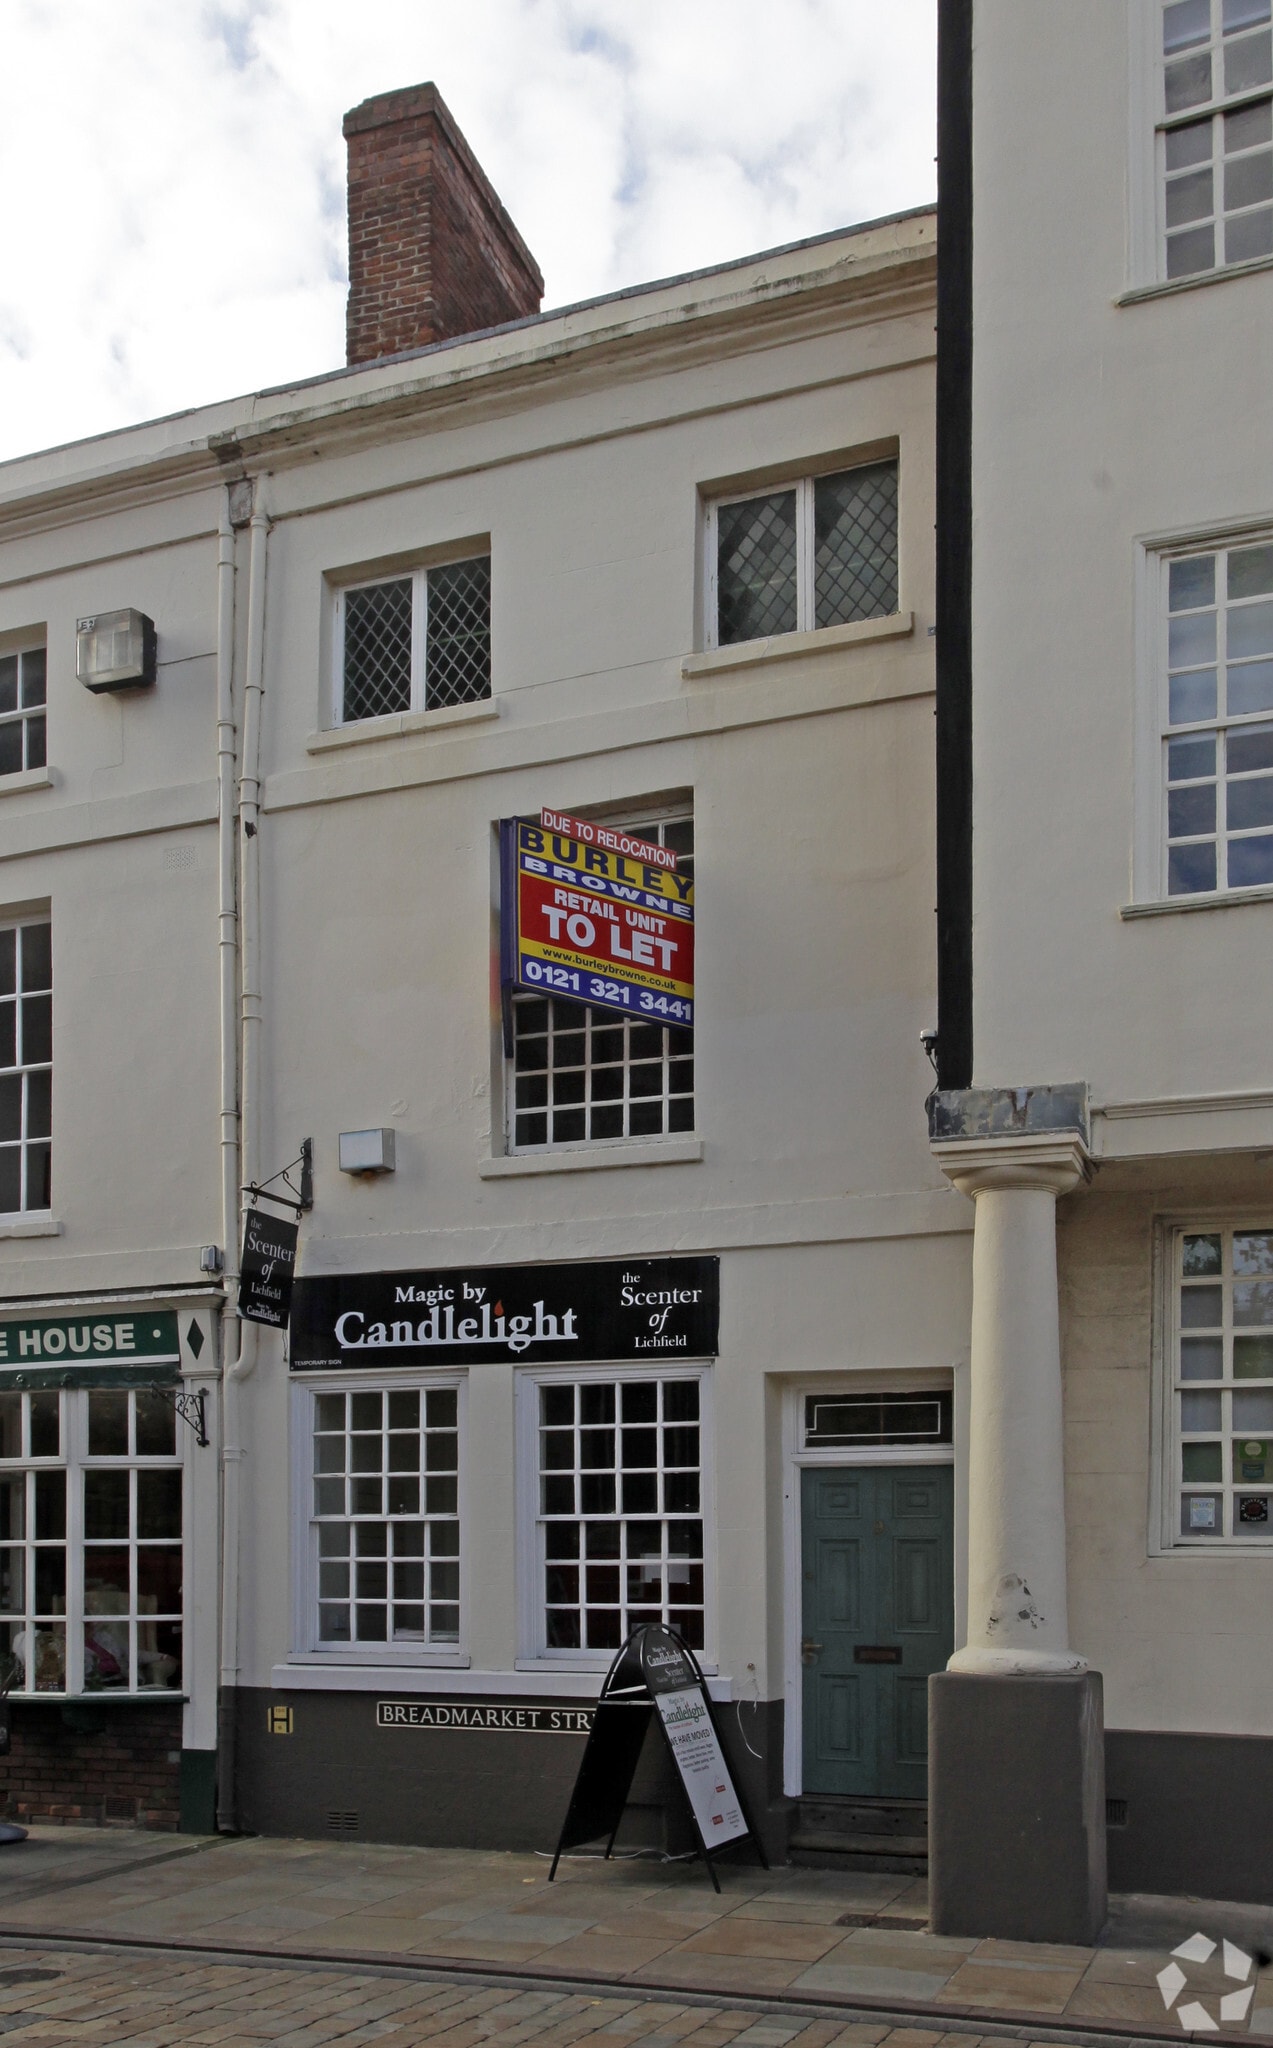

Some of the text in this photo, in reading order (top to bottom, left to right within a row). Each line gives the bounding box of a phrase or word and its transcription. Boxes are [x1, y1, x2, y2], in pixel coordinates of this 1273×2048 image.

[543, 811, 675, 869] DUE TO RELOCATION
[520, 826, 693, 900] BURLEY
[524, 856, 692, 918] BROWNE
[554, 888, 666, 935] RETAIL UNIT
[541, 904, 678, 971] TO LET
[542, 947, 676, 991] www.burleybrowne.co.uk
[525, 961, 692, 1021] 0121 321 3441
[250, 1217, 262, 1230] the
[247, 1231, 294, 1262] Scenter
[261, 1259, 277, 1284] of
[622, 1272, 641, 1284] the
[251, 1281, 281, 1300] Lichfield
[394, 1282, 487, 1307] Magic by
[620, 1286, 702, 1308] Scenter
[246, 1304, 281, 1322] Candlelight
[648, 1308, 670, 1334] of
[334, 1300, 579, 1353] Candlelight
[19, 1323, 136, 1356] HOUSE
[634, 1335, 687, 1349] Lichfield
[646, 1650, 684, 1667] Candlelight
[382, 1705, 595, 1729] BREADMARKET STR
[679, 1733, 692, 1744] HAVE
[691, 1728, 710, 1741] MOVED
